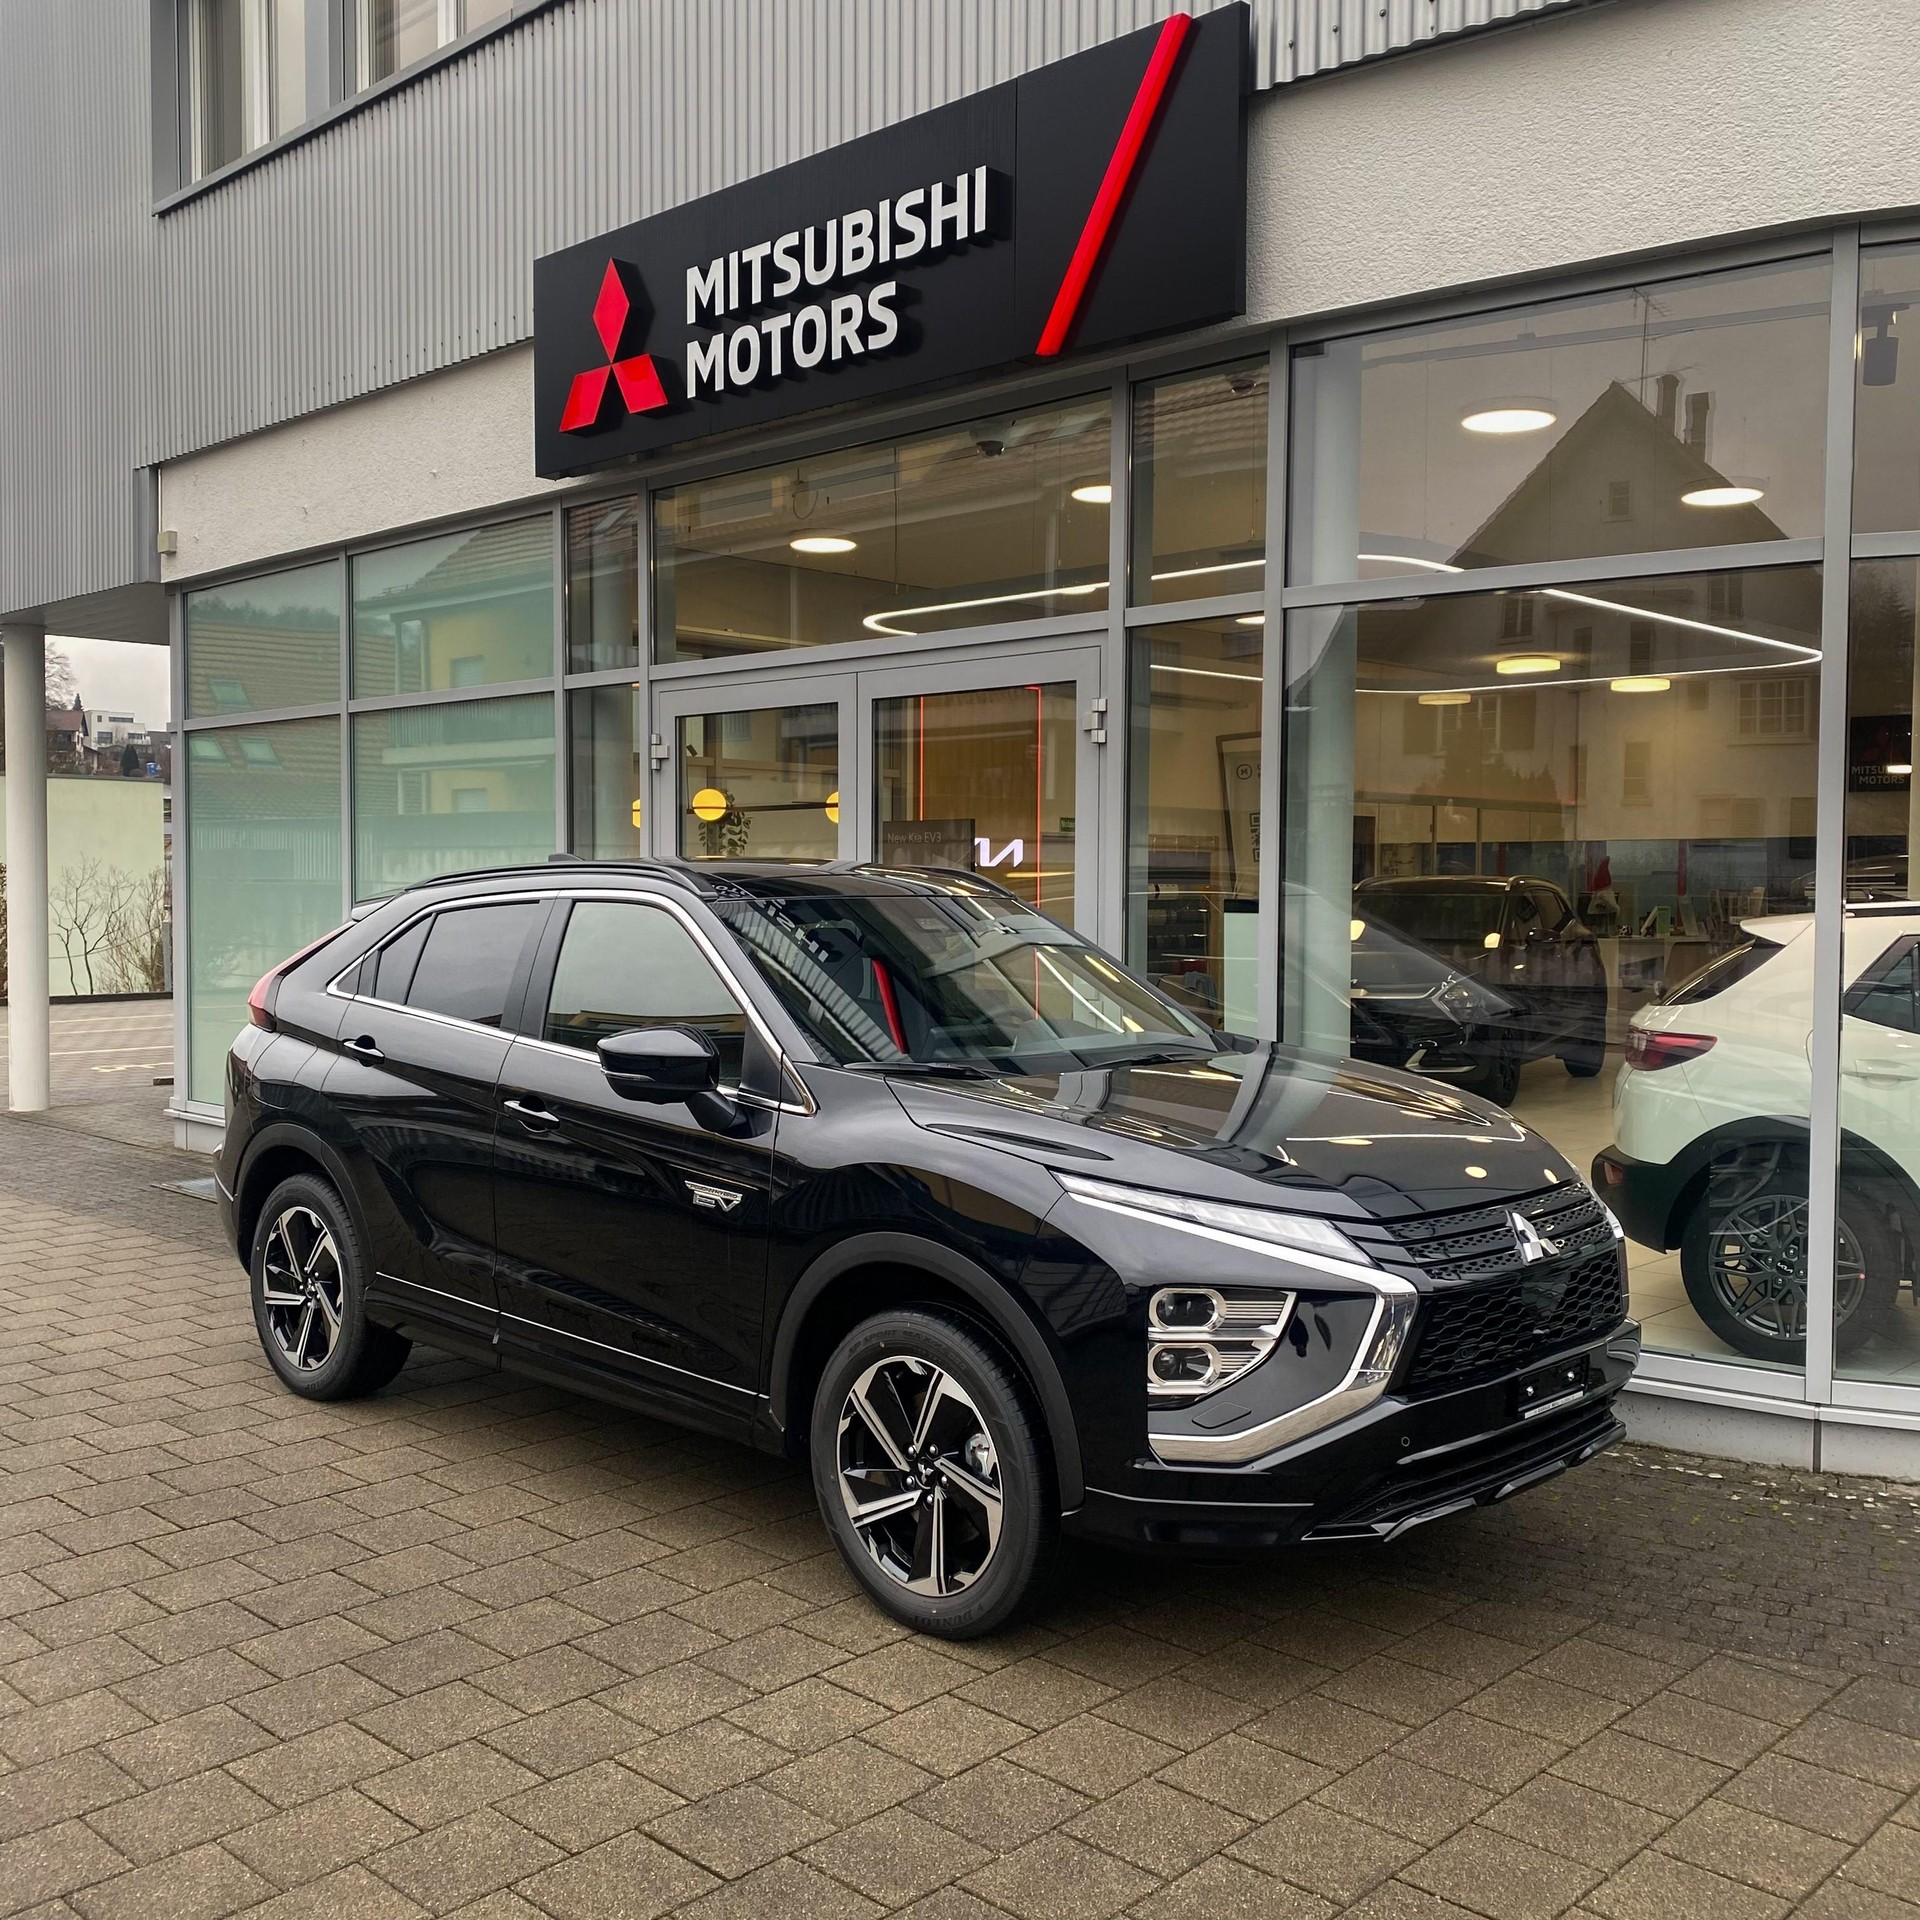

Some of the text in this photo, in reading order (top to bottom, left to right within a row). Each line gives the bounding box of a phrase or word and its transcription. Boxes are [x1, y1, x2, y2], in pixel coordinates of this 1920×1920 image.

[686, 164, 987, 325] MITSUBISHI
[686, 280, 898, 399] MOTORS
[1859, 775, 1905, 785] MOTORS
[887, 831, 942, 843] New Kia EV3
